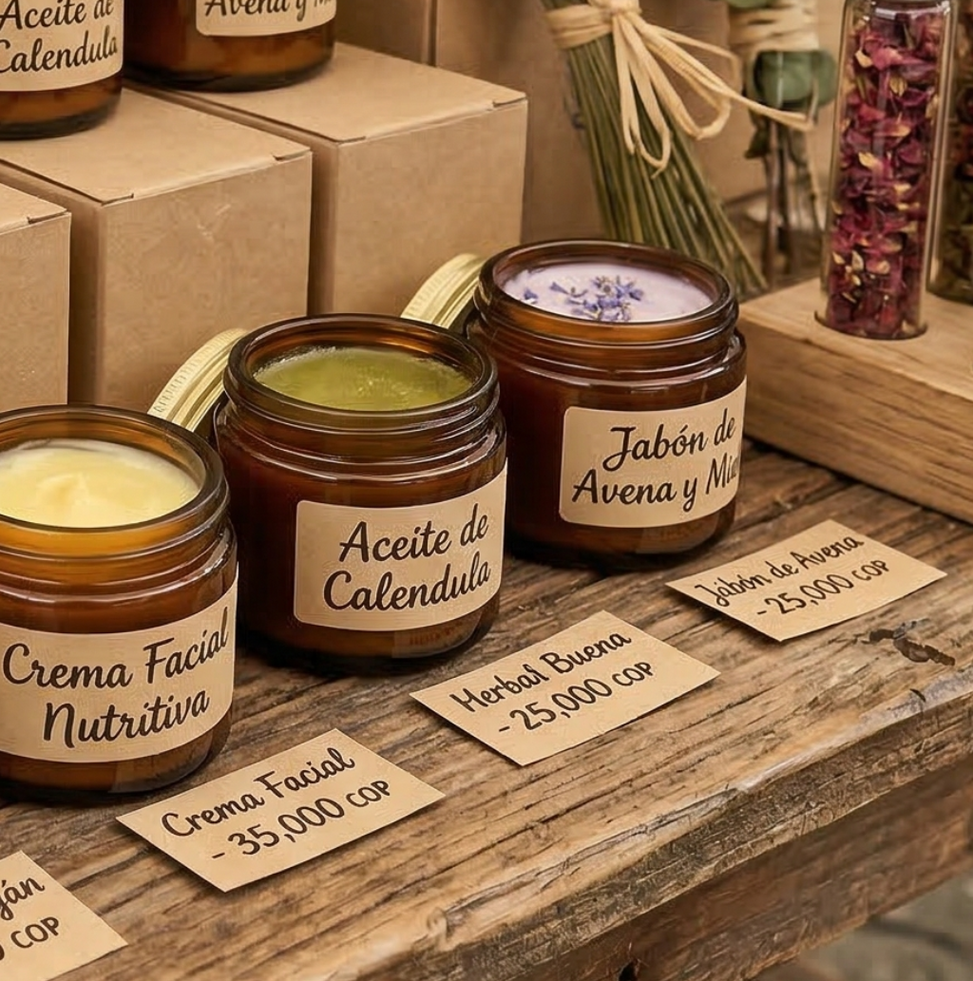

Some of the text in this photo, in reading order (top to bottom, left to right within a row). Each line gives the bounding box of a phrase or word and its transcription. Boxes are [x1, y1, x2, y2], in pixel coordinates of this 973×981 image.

[602, 407, 737, 473] Jabón de
[571, 468, 678, 506] Avena
[682, 476, 698, 513] y
[339, 502, 490, 563] Aceite de
[764, 560, 800, 579] de
[789, 534, 865, 569] Avena
[323, 551, 492, 611] Calendula
[850, 559, 891, 582] COP
[1, 606, 230, 700] Crema Facial
[449, 632, 633, 713] Herbal Buena
[611, 661, 654, 688] COP
[42, 684, 211, 750] Nutritiva
[161, 746, 356, 838] Crema Facial
[345, 779, 391, 809] COP
[9, 915, 61, 950] COP
